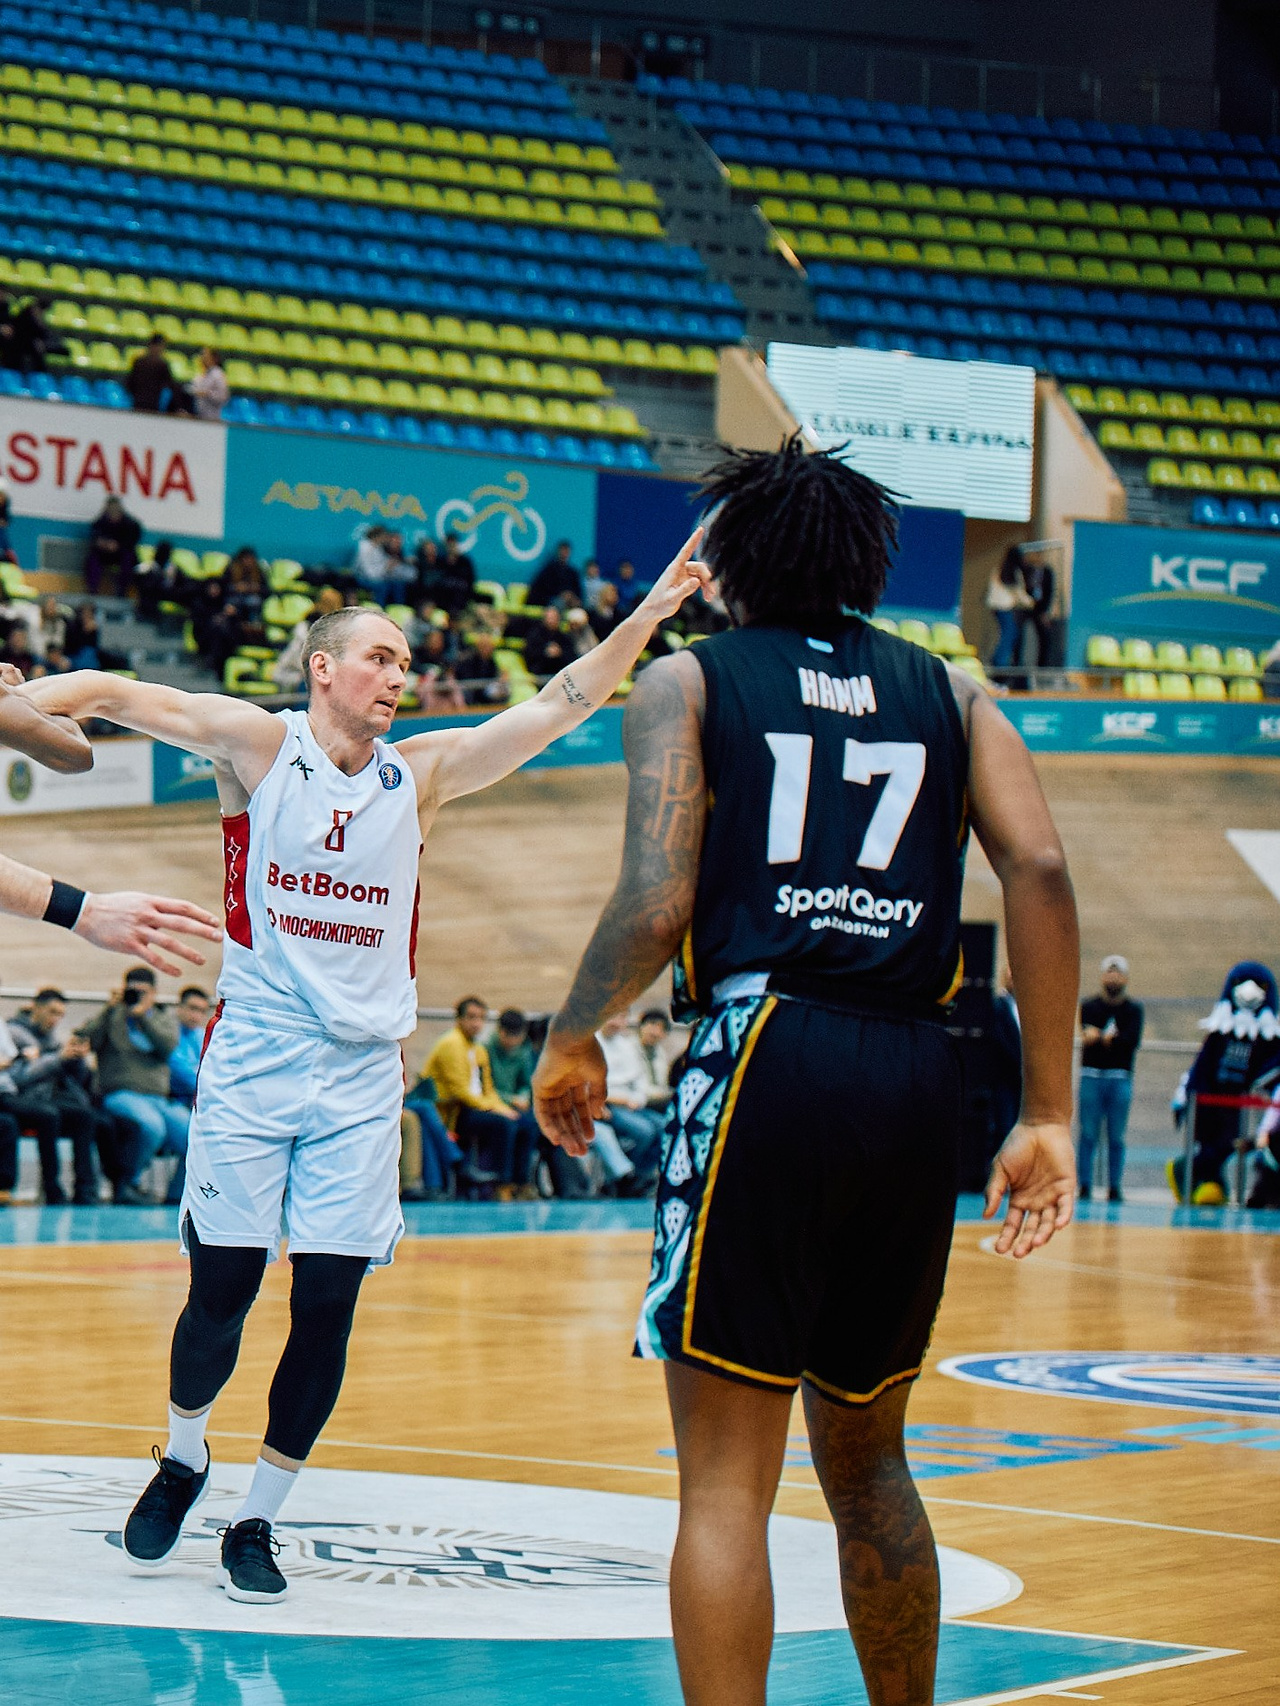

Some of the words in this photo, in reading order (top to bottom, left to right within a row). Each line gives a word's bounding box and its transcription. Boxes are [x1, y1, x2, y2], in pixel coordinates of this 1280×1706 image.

[261, 478, 427, 522] ASTANA
[1150, 553, 1268, 595] KCF
[764, 732, 926, 871] 17
[324, 809, 353, 852] 8
[267, 861, 390, 906] BetBoom
[775, 884, 924, 928] SportQory
[279, 913, 384, 948] МОСИНЖПРОЕКТ
